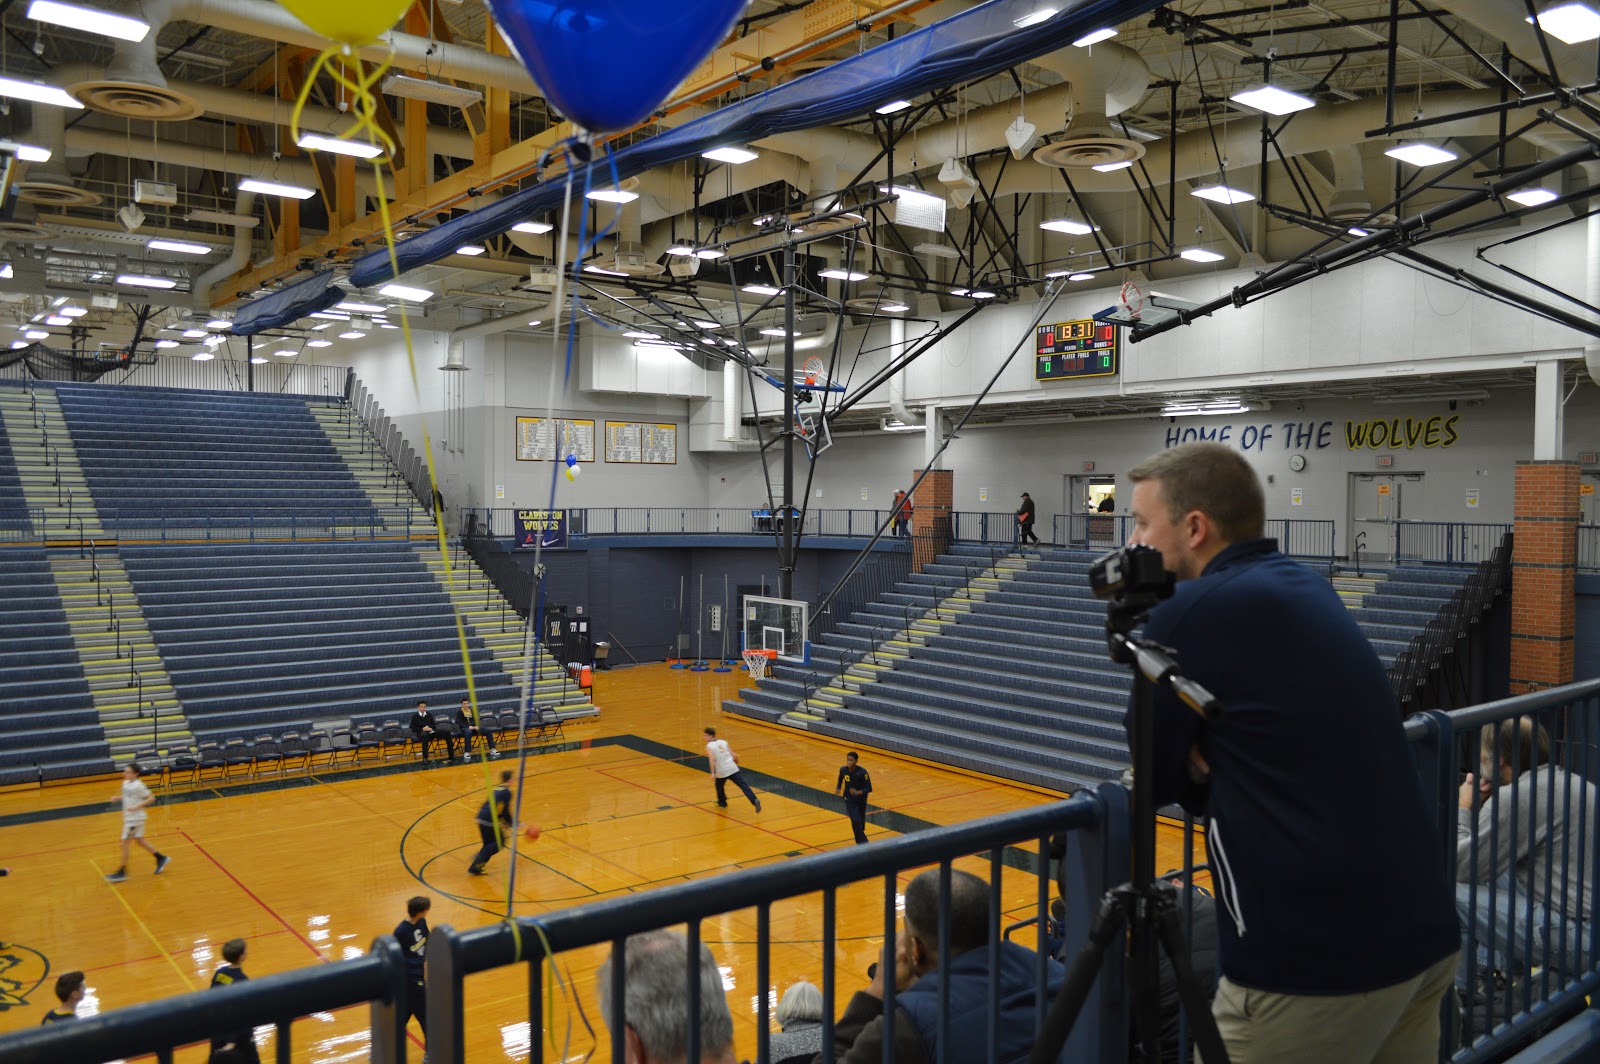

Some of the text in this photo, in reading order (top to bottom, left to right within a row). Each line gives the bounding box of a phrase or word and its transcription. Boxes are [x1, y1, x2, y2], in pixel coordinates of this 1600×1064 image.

[1038, 325, 1054, 334] HOME
[1062, 323, 1091, 339] 13:31
[1105, 325, 1112, 340] 0
[1046, 333, 1054, 347] 0
[1241, 424, 1273, 450] OF
[1284, 421, 1333, 450] THE
[1345, 415, 1460, 451] WOLVES
